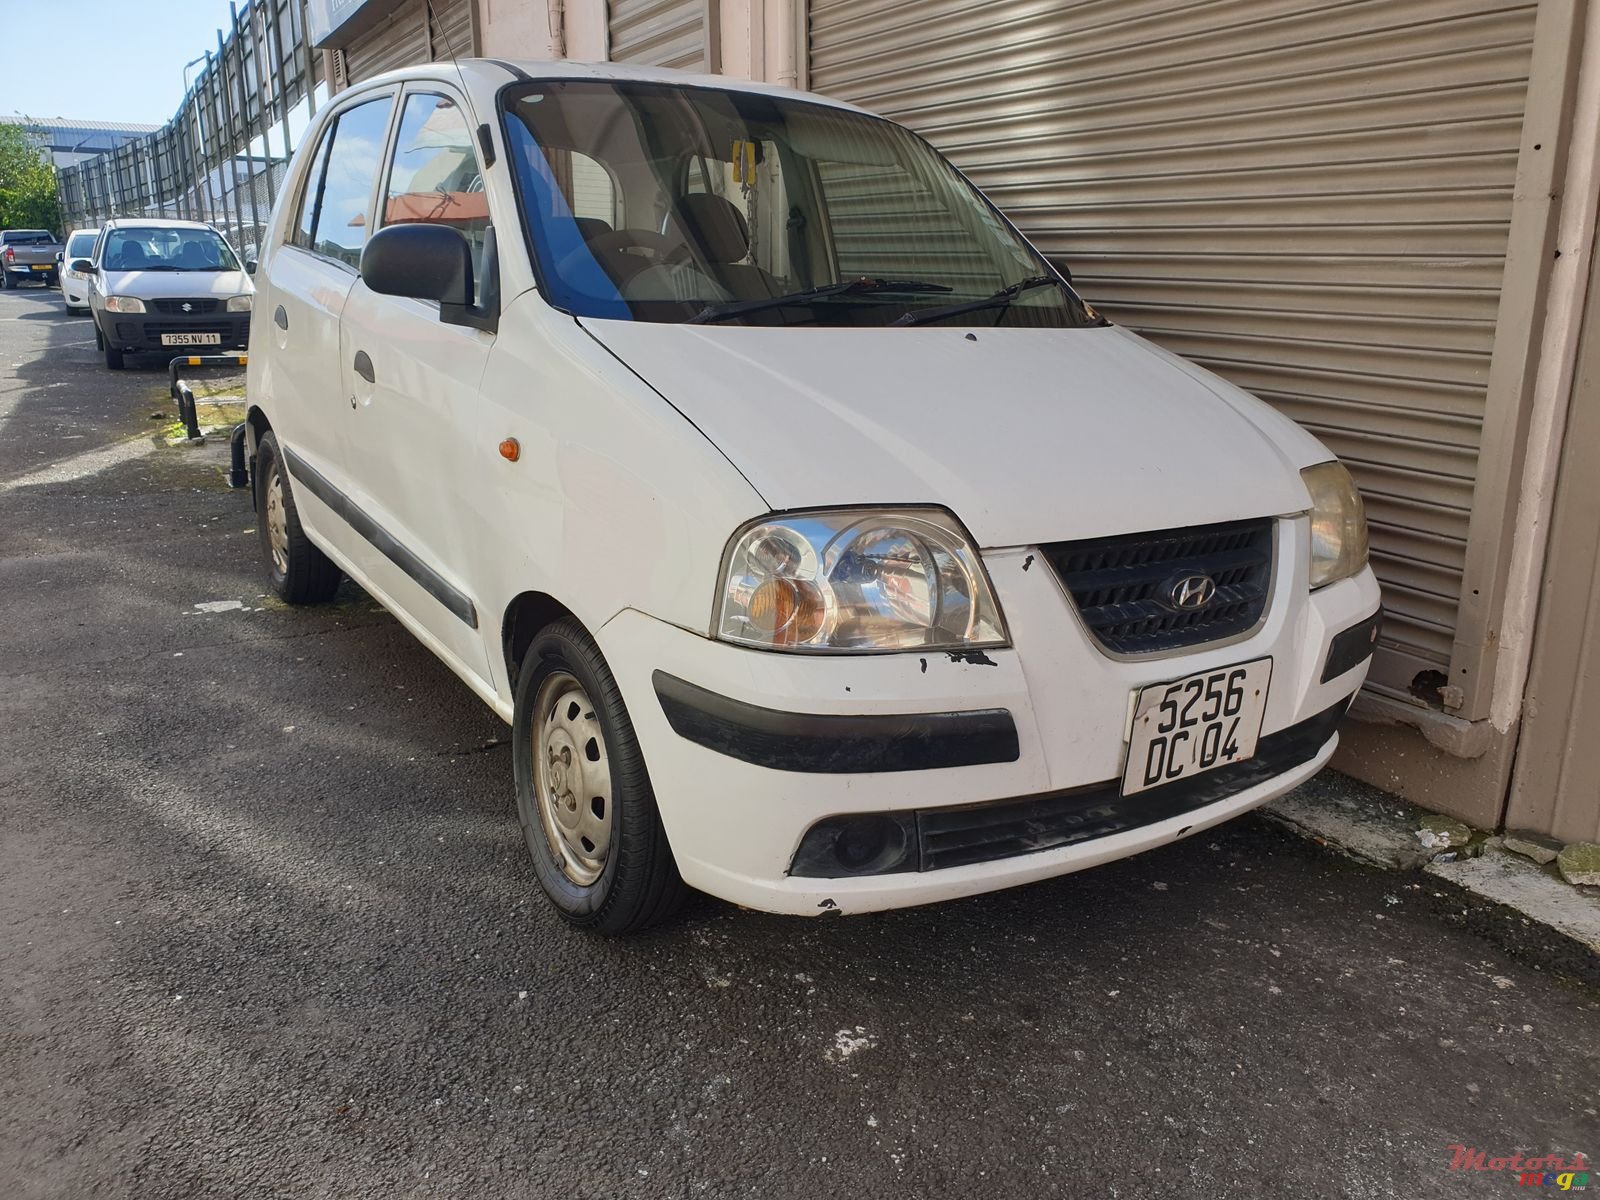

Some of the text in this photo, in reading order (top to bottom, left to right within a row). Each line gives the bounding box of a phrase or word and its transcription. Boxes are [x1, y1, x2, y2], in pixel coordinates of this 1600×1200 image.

[191, 335, 203, 344] NV
[206, 334, 217, 343] 11
[1157, 668, 1247, 734] 5256
[1143, 716, 1241, 787] DC 04
